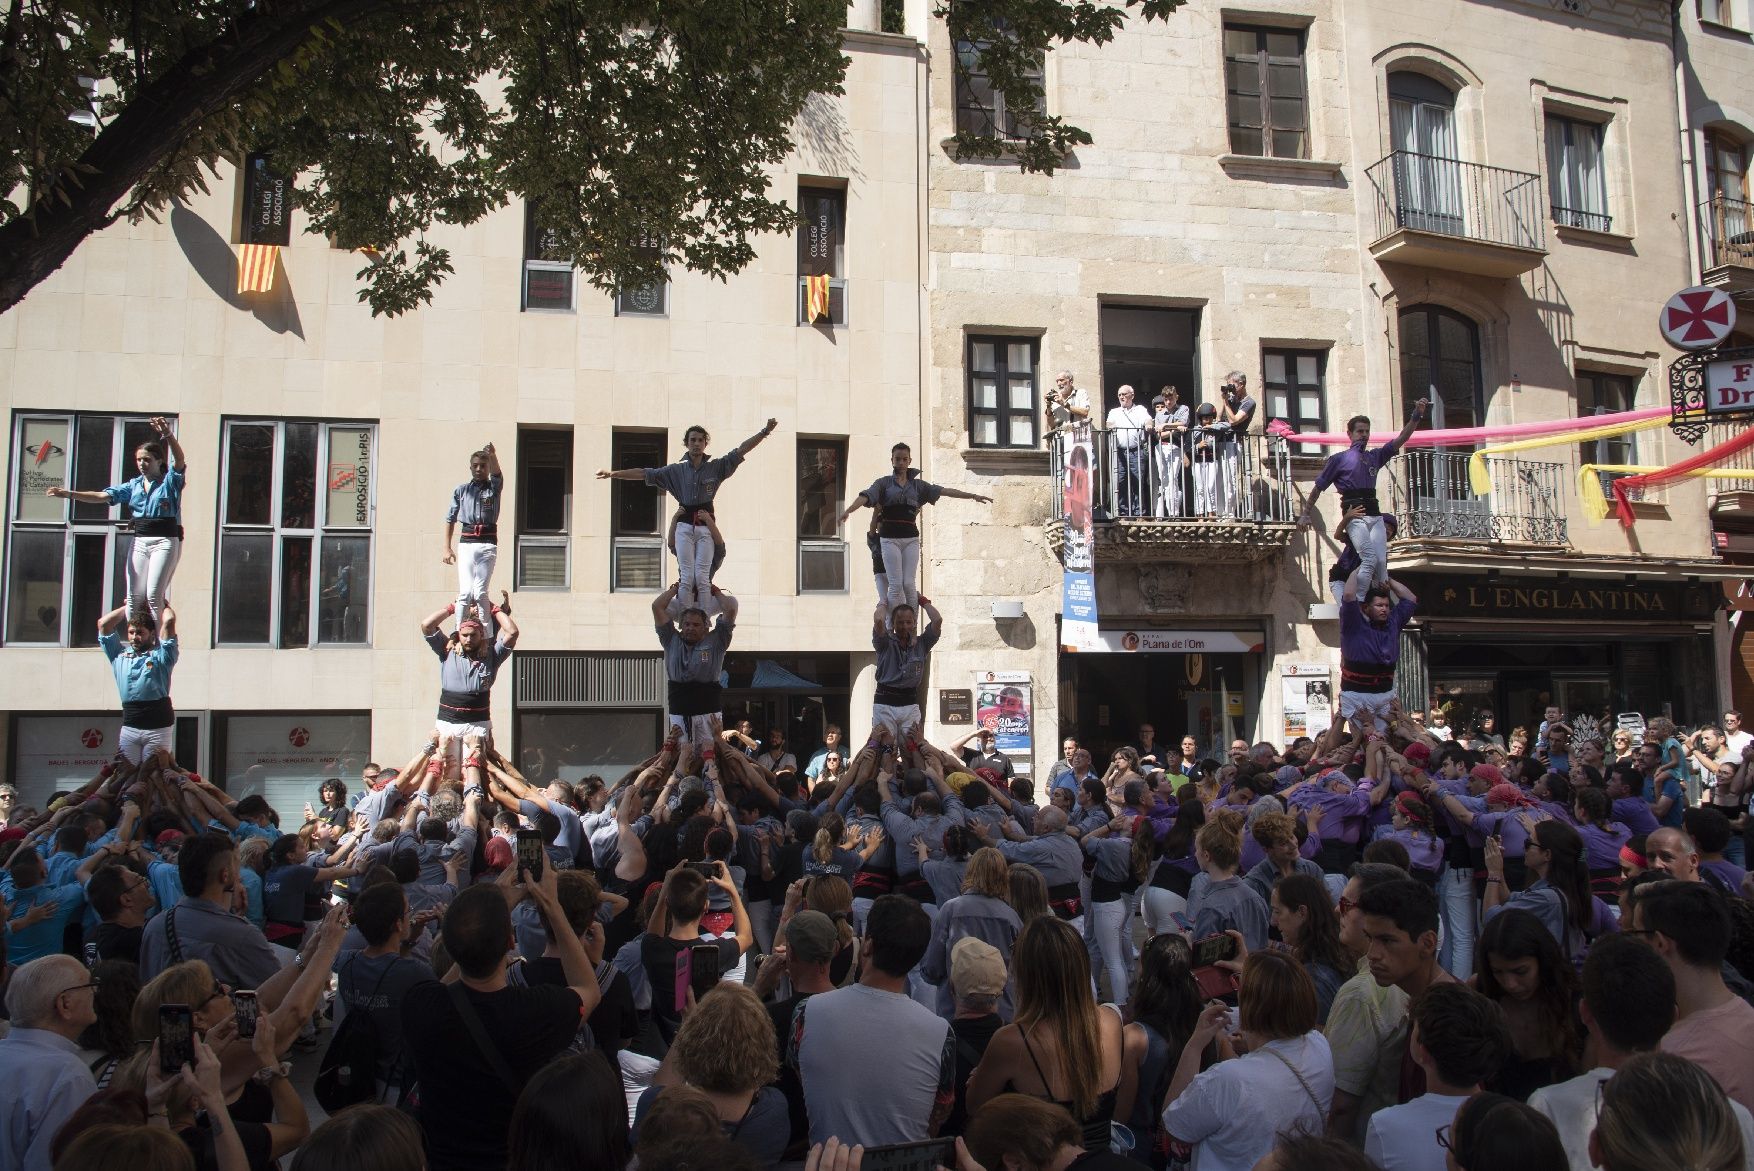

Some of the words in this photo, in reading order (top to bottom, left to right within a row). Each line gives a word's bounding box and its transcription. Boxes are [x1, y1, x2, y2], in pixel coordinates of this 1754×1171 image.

[356, 465, 368, 522] EXPOSICIÓ
[1468, 586, 1666, 611] L'ENGLANTINA
[1172, 639, 1183, 649] de
